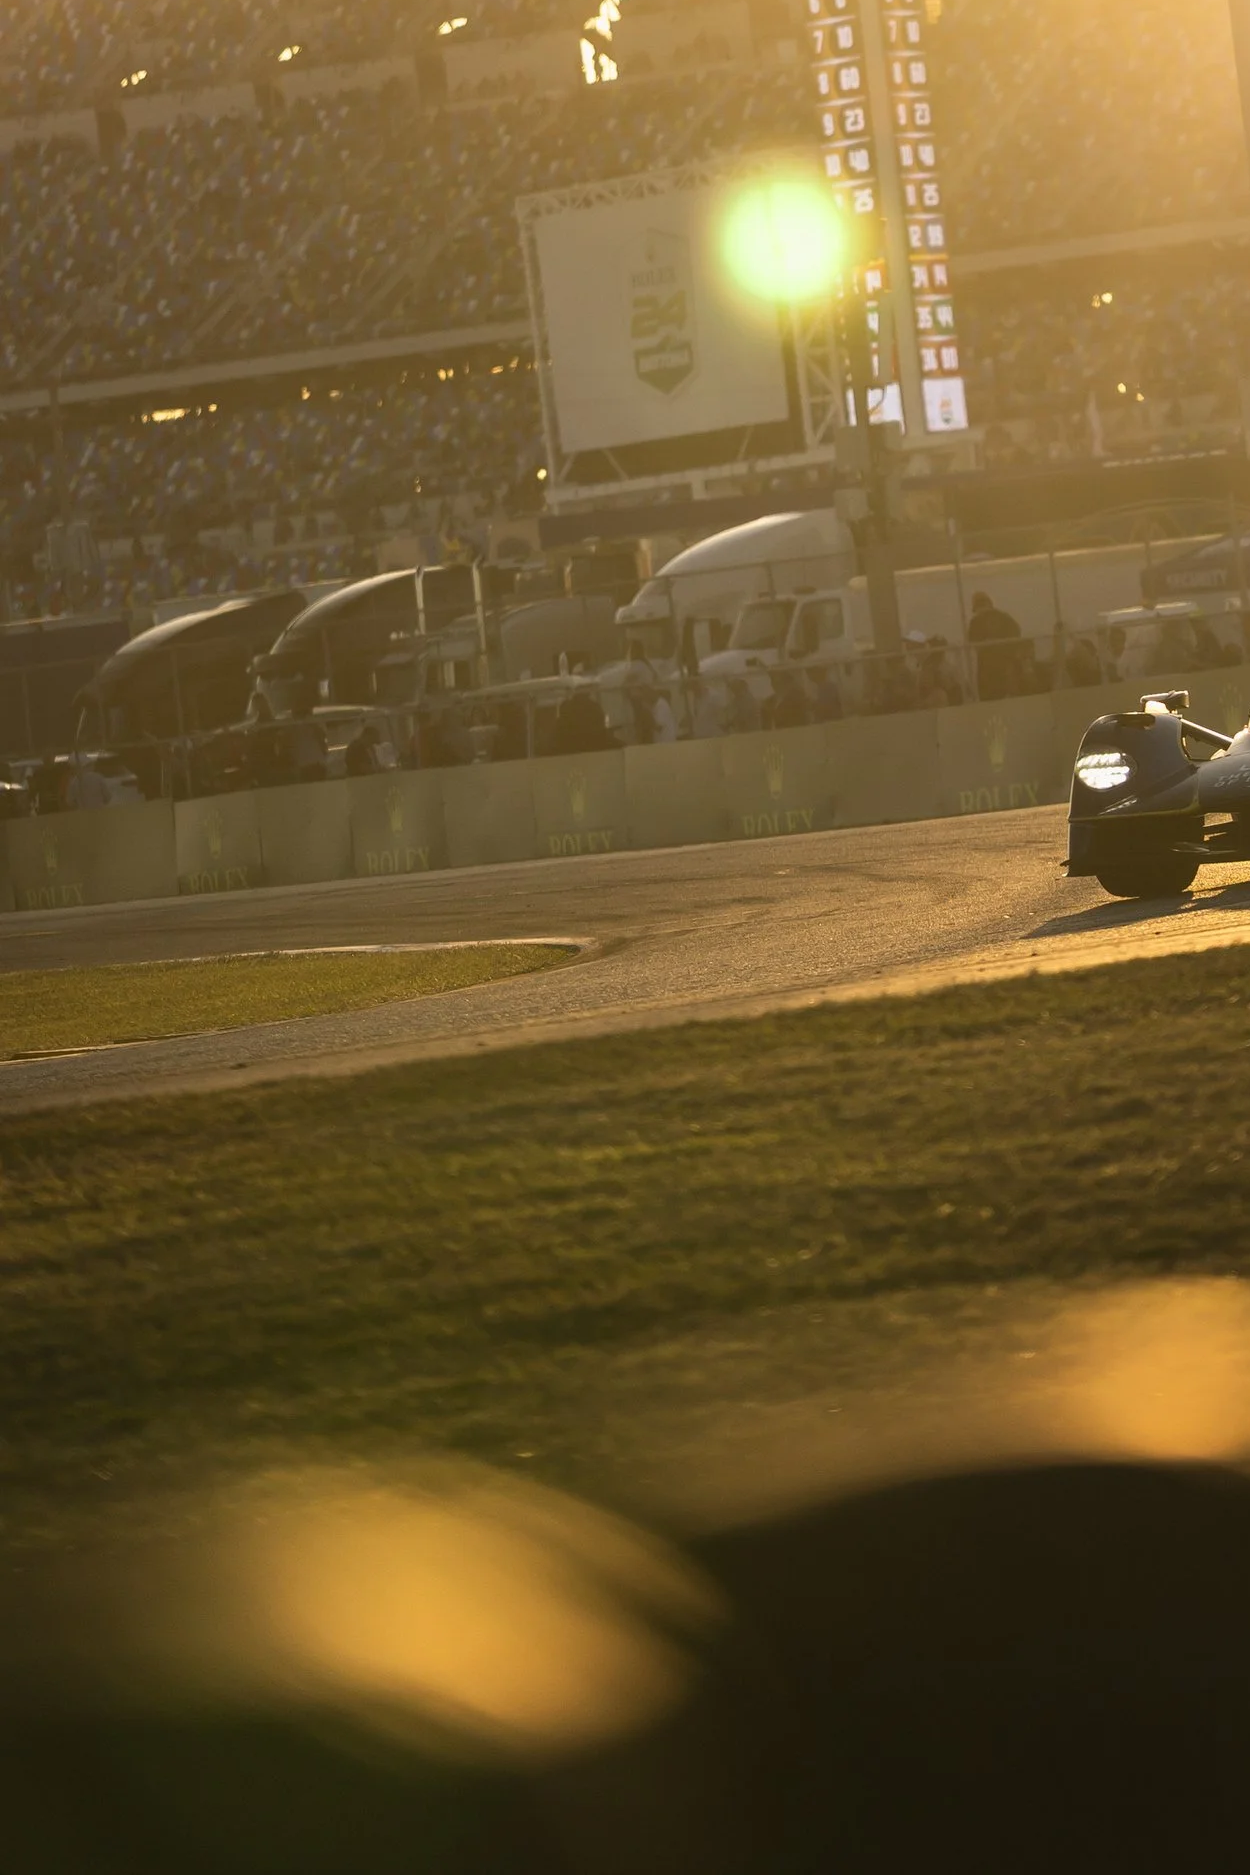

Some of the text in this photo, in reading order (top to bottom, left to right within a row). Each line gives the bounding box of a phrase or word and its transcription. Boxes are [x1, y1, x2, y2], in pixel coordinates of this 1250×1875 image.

[813, 29, 823, 54] 7
[888, 19, 897, 43] 7
[844, 107, 865, 133] 23
[914, 102, 931, 126] 23
[853, 188, 874, 214] 25
[922, 183, 939, 206] 25
[909, 225, 922, 248] 12
[911, 266, 929, 288] 34
[631, 290, 686, 339] 24
[916, 306, 932, 329] 35
[1217, 772, 1250, 782] THE
